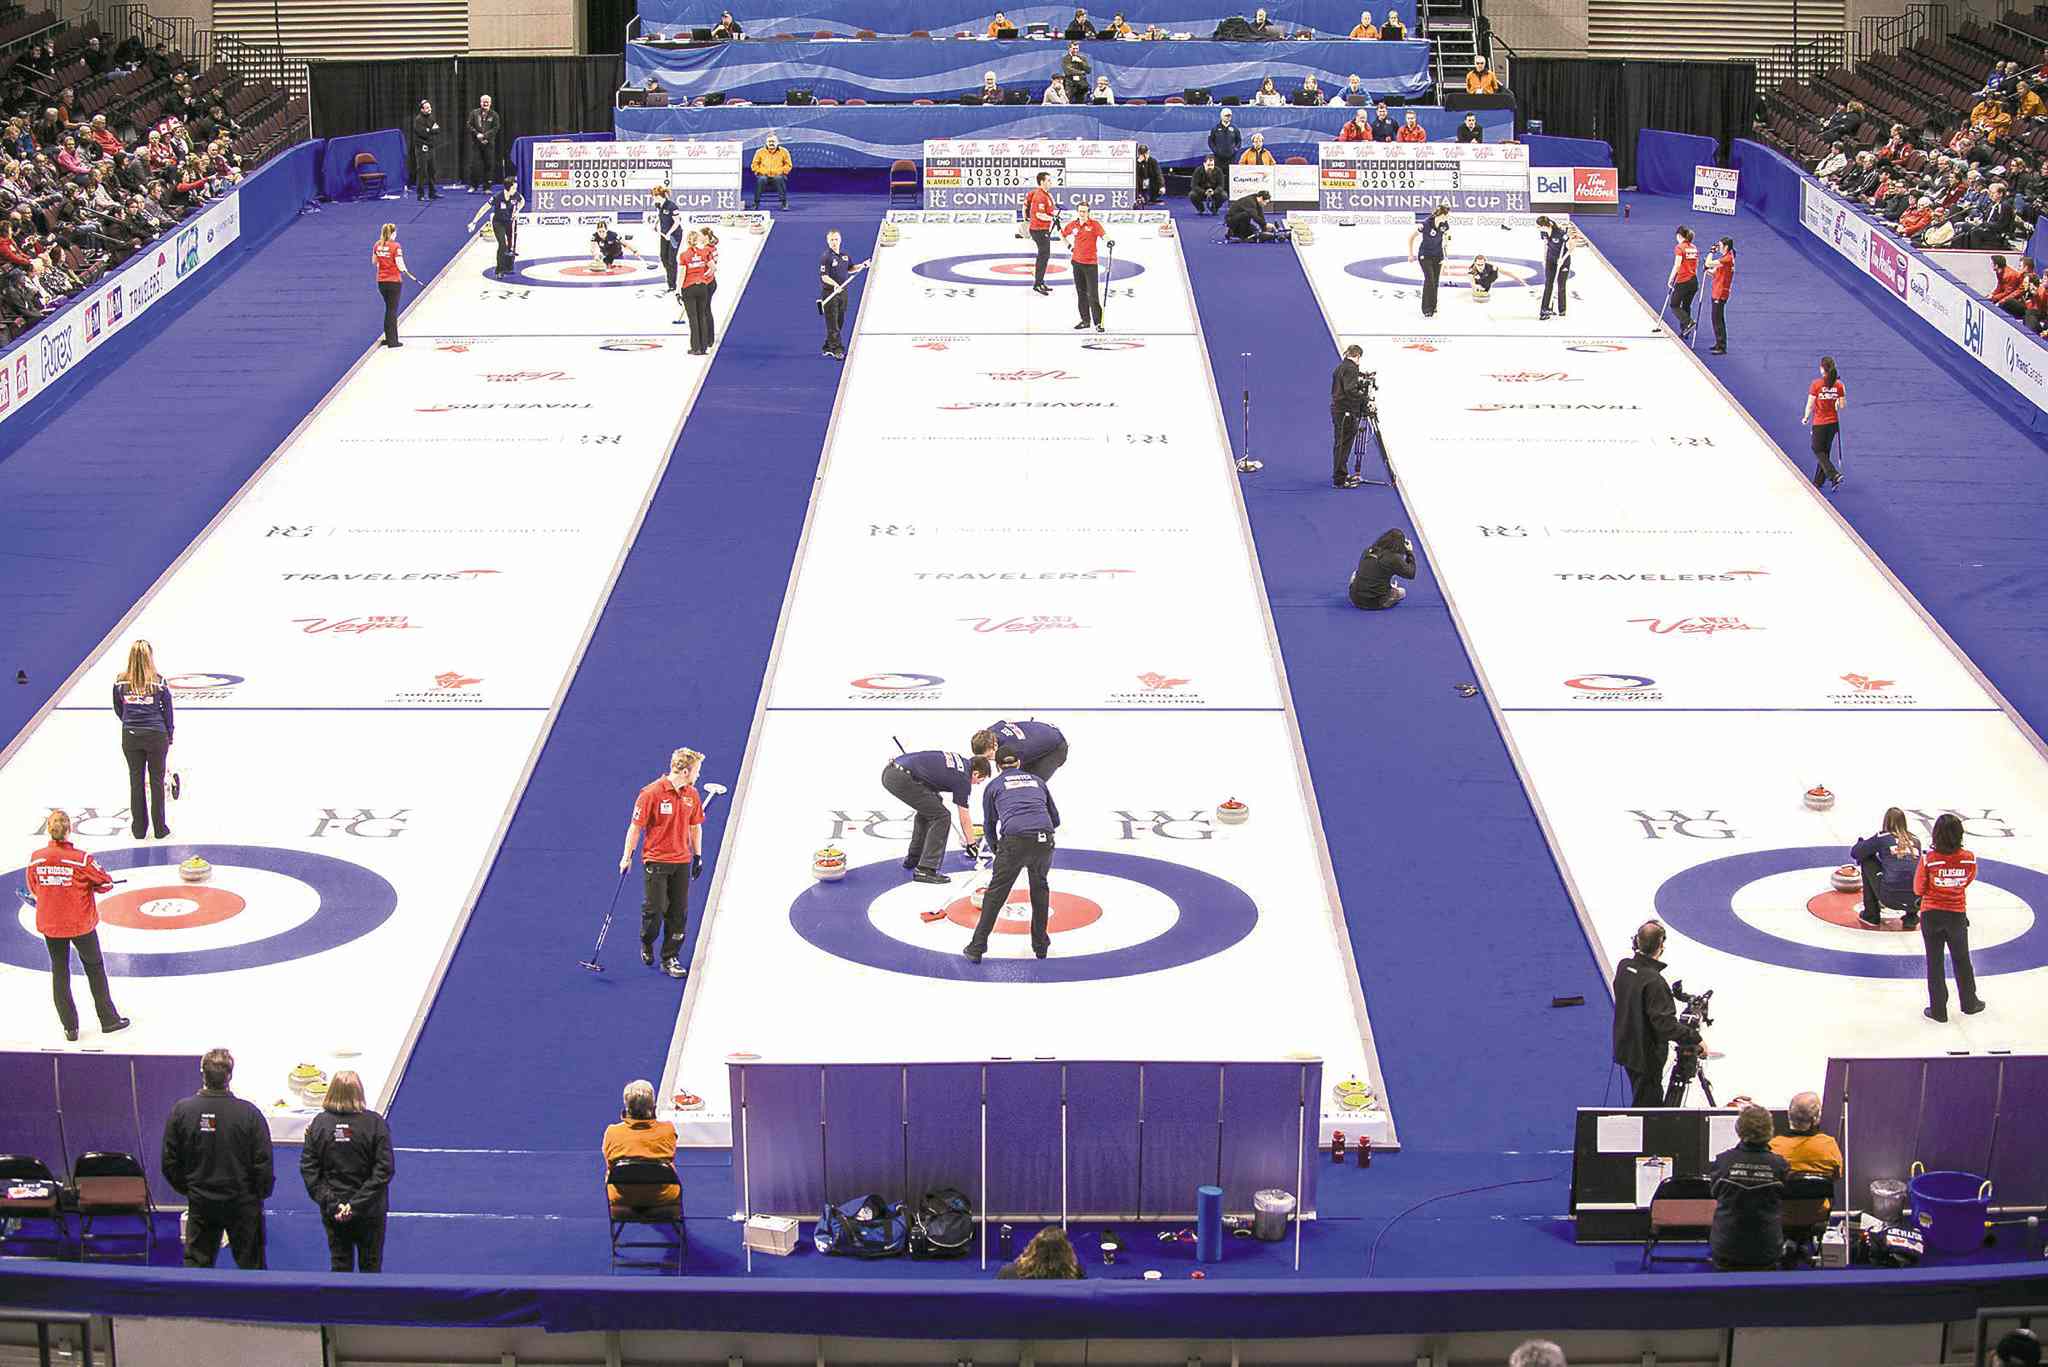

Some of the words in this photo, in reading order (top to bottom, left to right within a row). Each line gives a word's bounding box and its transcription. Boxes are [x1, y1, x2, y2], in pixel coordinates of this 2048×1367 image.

[1537, 176, 1567, 193] Bell
[1587, 173, 1606, 186] Tim
[1713, 180, 1718, 188] 6
[1575, 183, 1616, 198] Hortons
[1704, 188, 1728, 198] WORLD
[560, 195, 657, 207] CONTINENT
[676, 194, 711, 207] CUP
[953, 193, 1064, 205] CONTINEL
[1070, 192, 1105, 205] CUP
[1350, 195, 1459, 207] CONTINENTAL
[1465, 196, 1500, 208] CUP
[129, 271, 160, 313] TRAVELERS
[1964, 300, 1984, 356] Bell
[41, 325, 72, 382] Purex
[914, 572, 1098, 580] TRAVELERS
[1554, 574, 1736, 582] TRAVELERS
[292, 616, 423, 634] Vegas
[956, 616, 1092, 634] Vegas
[1626, 617, 1767, 634] Vegas
